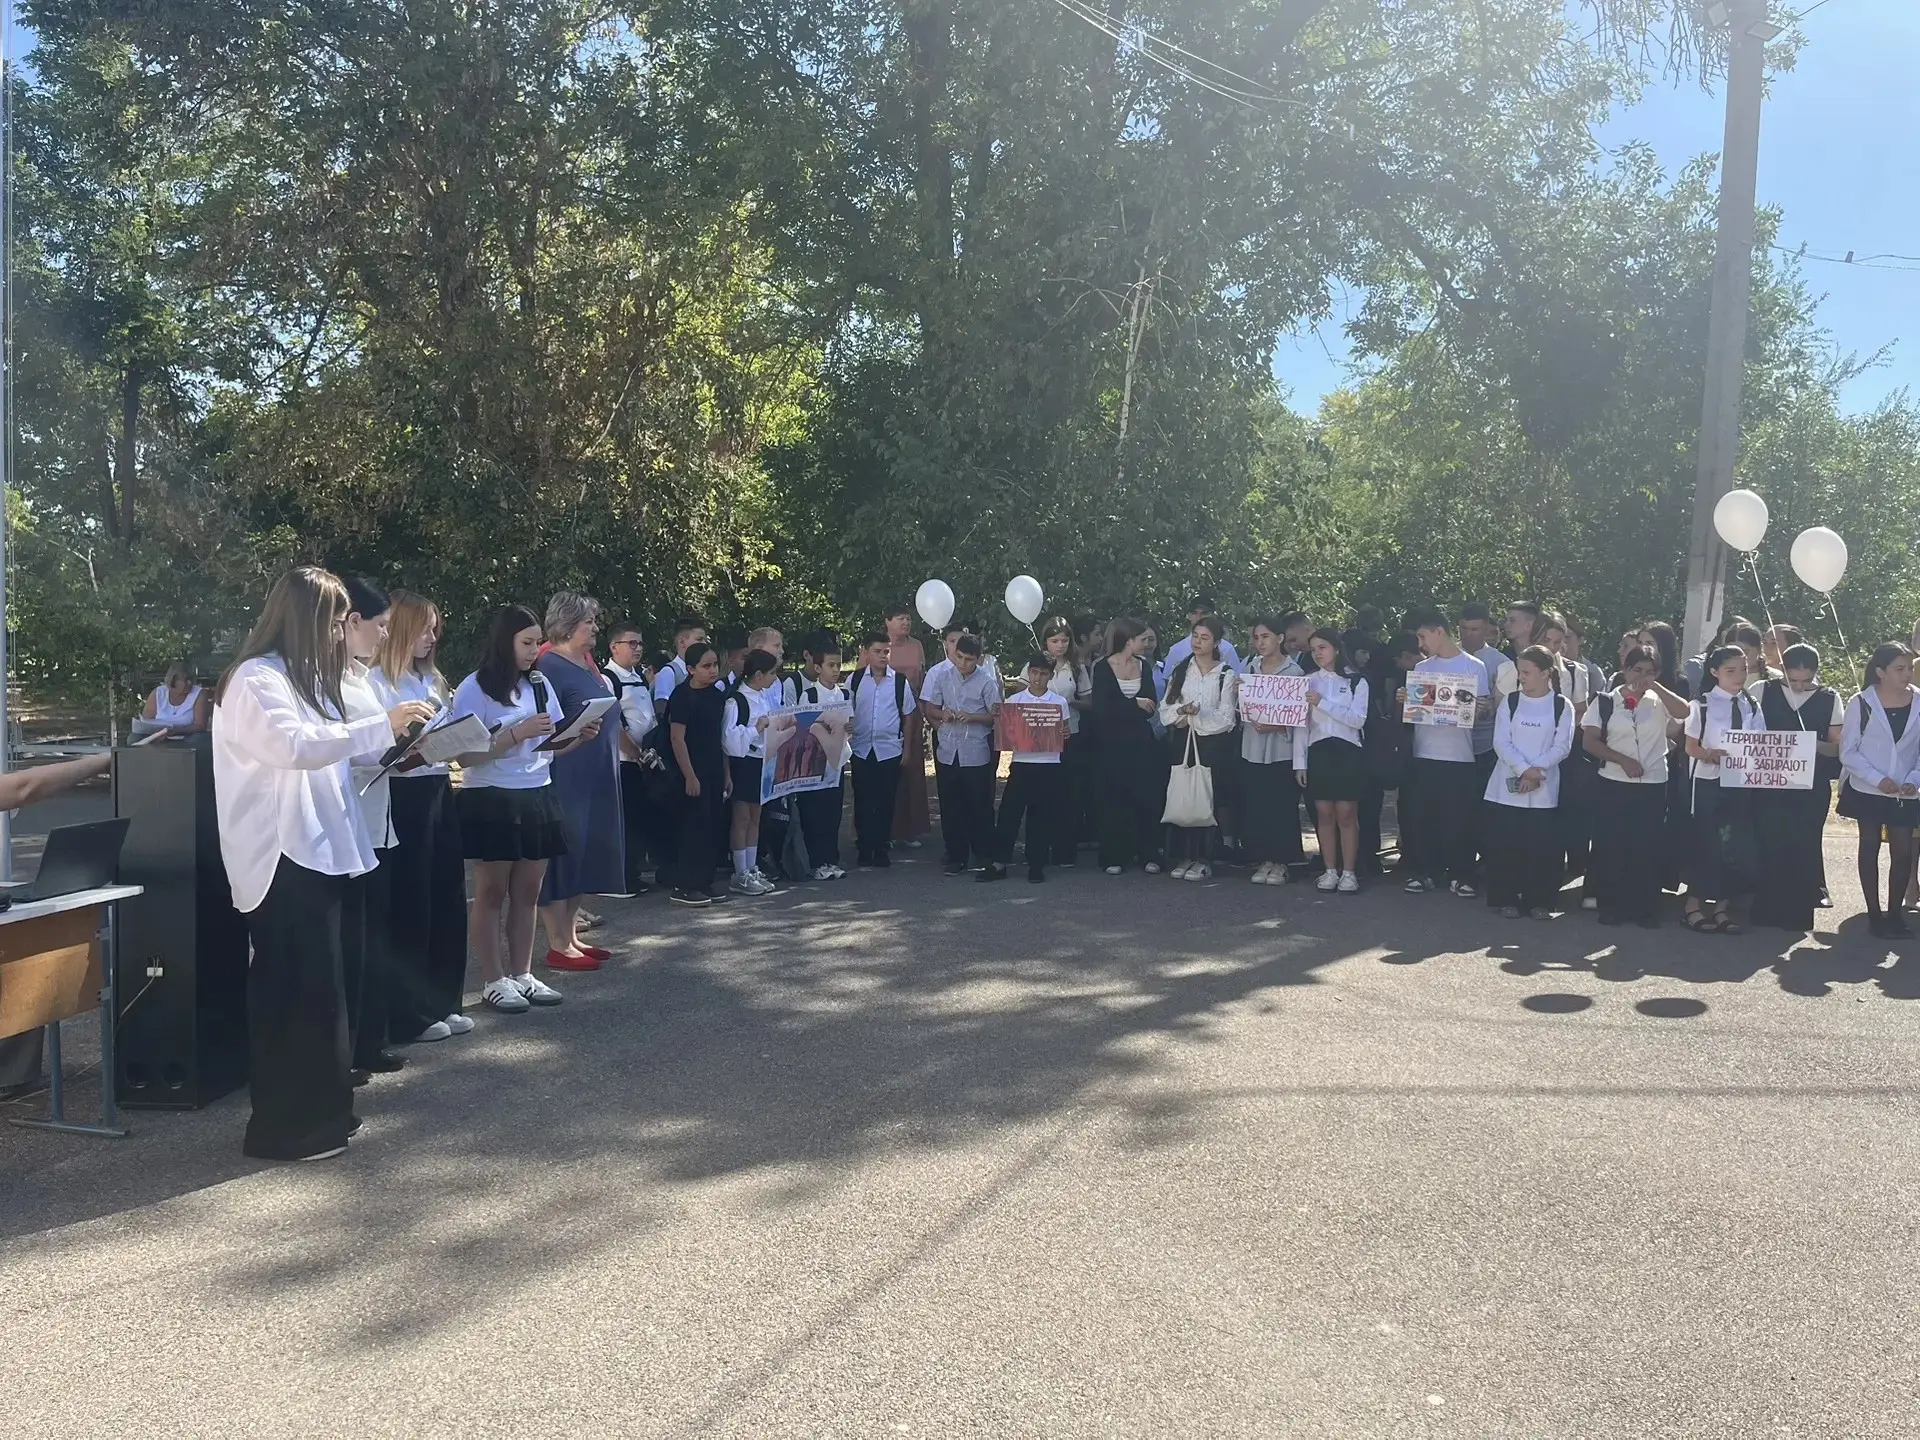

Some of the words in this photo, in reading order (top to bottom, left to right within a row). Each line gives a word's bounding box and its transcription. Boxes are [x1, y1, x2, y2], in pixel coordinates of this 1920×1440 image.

[1785, 734, 1798, 745] НЕ
[1743, 745, 1791, 758] ПЛАТЯТ
[1725, 757, 1747, 770] ОНИ
[1754, 758, 1808, 772] ЗАБИРАЮТ
